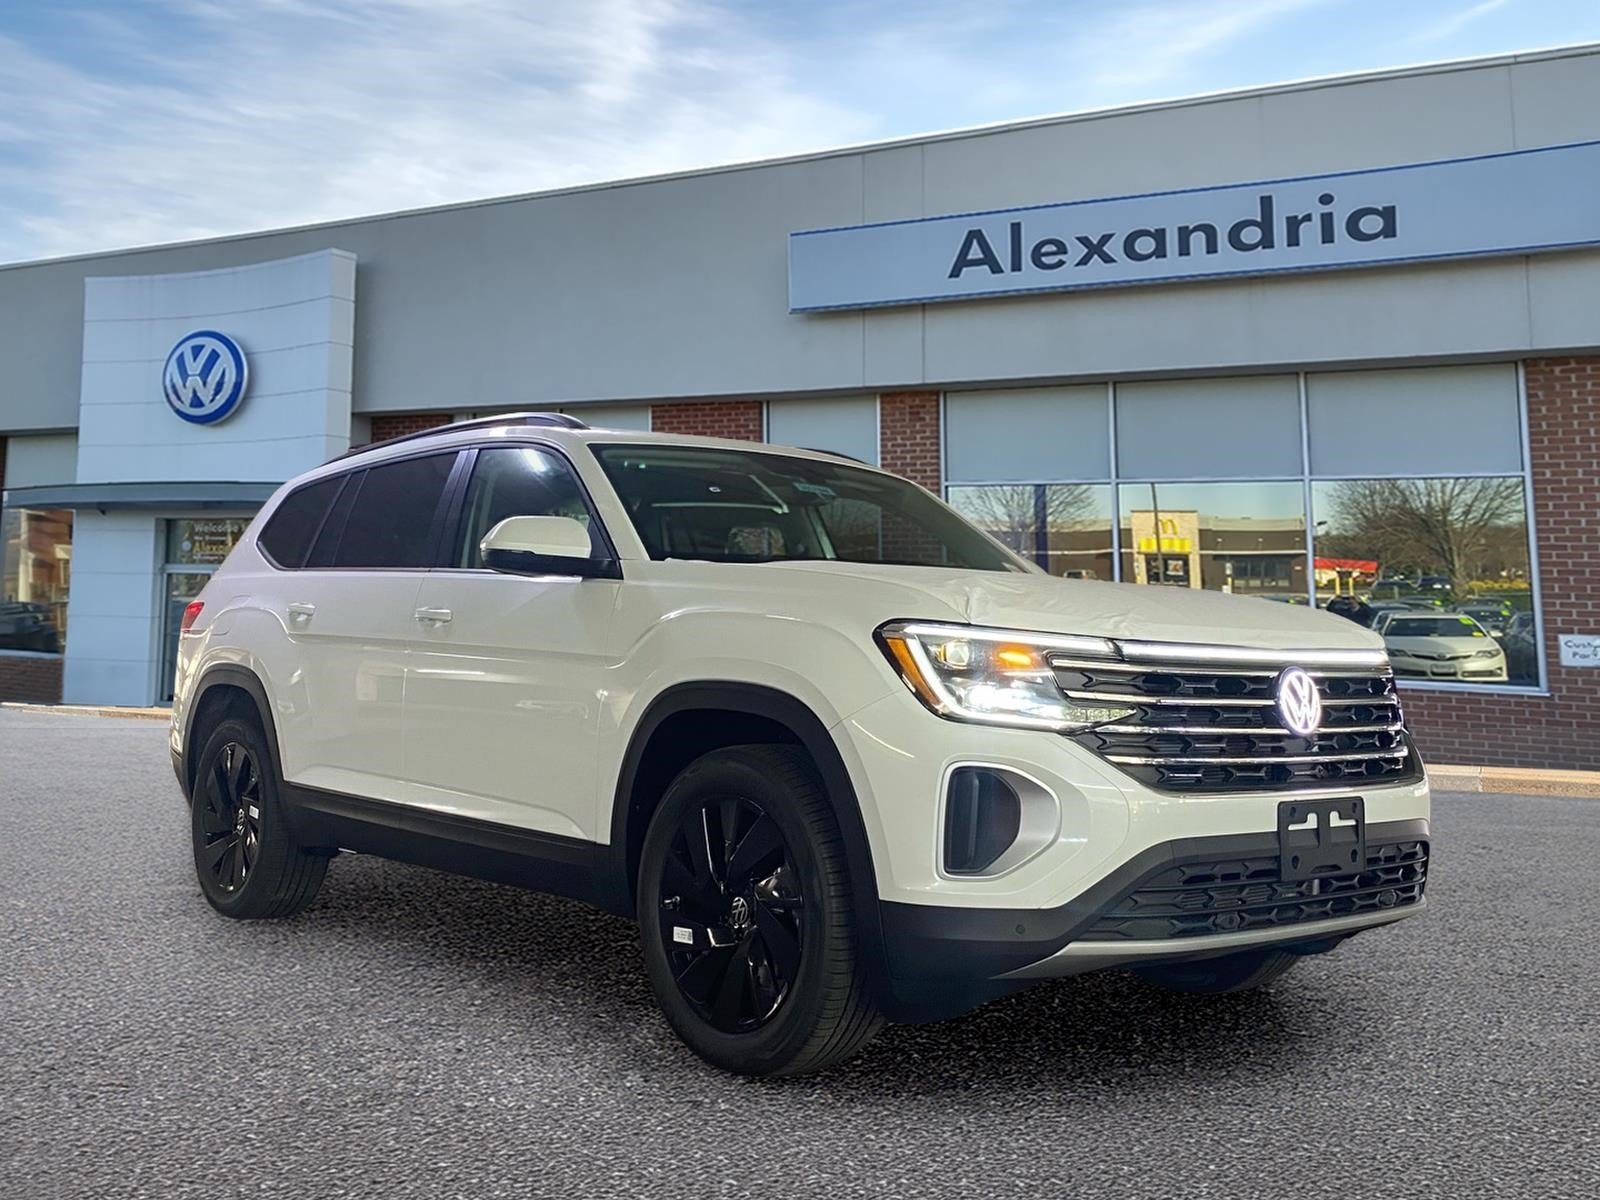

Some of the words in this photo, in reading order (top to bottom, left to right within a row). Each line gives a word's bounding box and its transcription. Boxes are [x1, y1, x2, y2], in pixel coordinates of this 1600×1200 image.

[947, 192, 1397, 279] Alexandria
[167, 337, 237, 416] VW
[1280, 671, 1320, 733] VW
